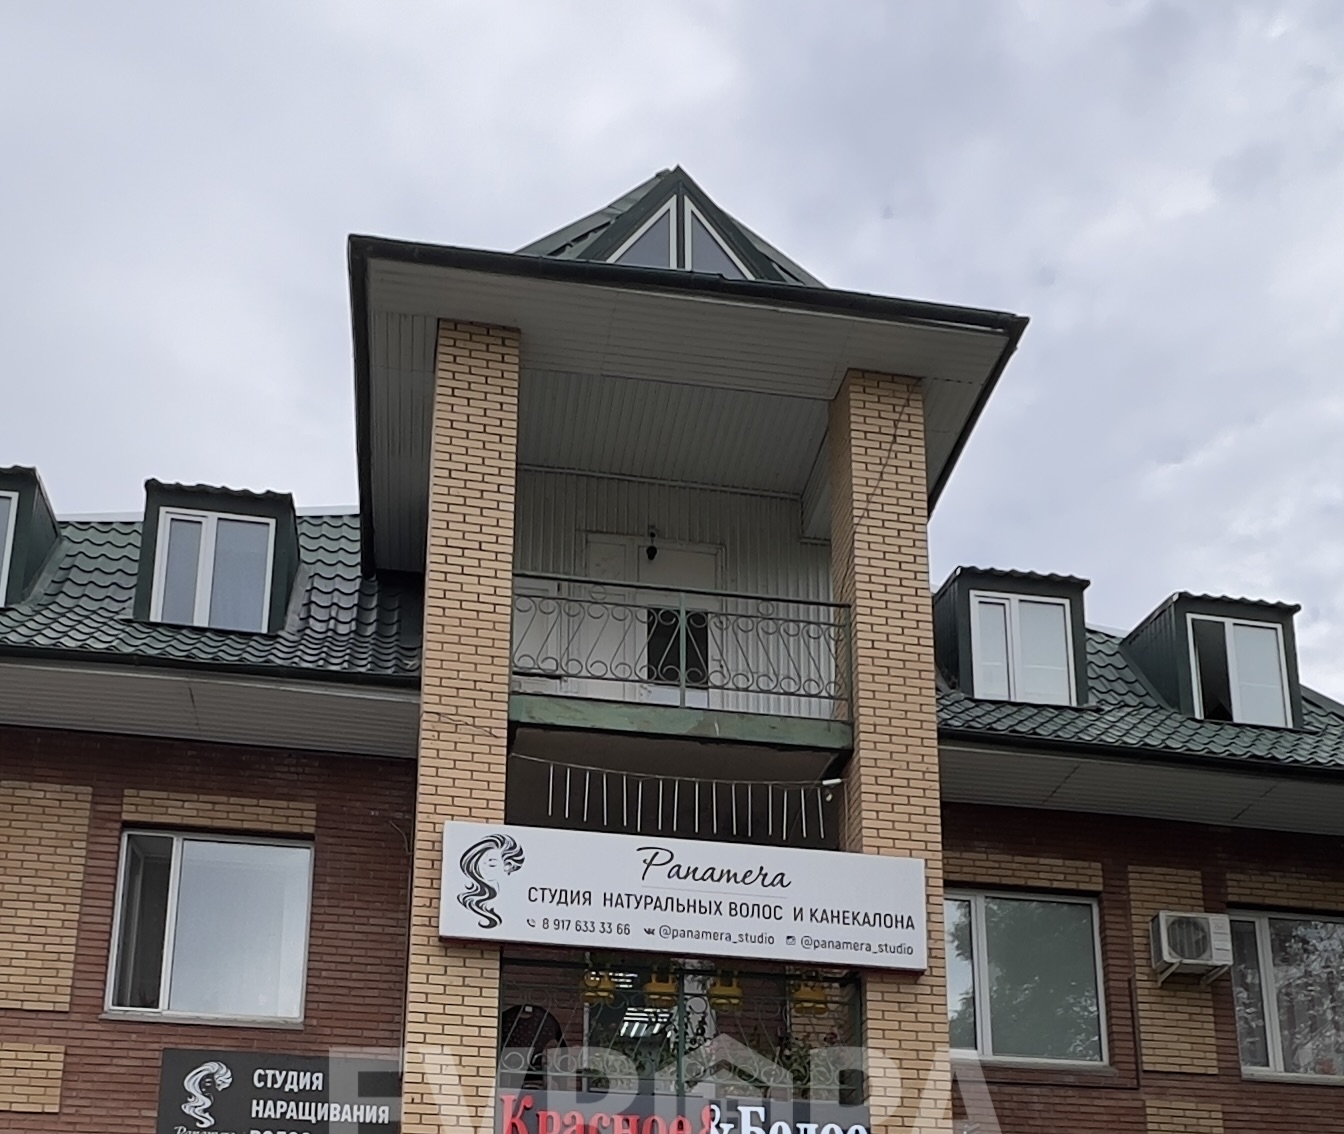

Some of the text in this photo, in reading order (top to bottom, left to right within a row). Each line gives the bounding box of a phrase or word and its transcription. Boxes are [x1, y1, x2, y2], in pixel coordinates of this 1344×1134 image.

[636, 846, 792, 889] Panamera
[528, 887, 916, 930] СТУДИЯ НАТУРАЛЬНЫХ ВОЛОС И КАНЕКАЛОНА
[542, 918, 631, 935] 8 917 633 33 66
[658, 924, 775, 945] @panamera_studio
[800, 935, 914, 955] @panamera_studio
[253, 1069, 324, 1093] СТУДИЯ
[251, 1099, 390, 1124] НАРАЩИВАНИЯ
